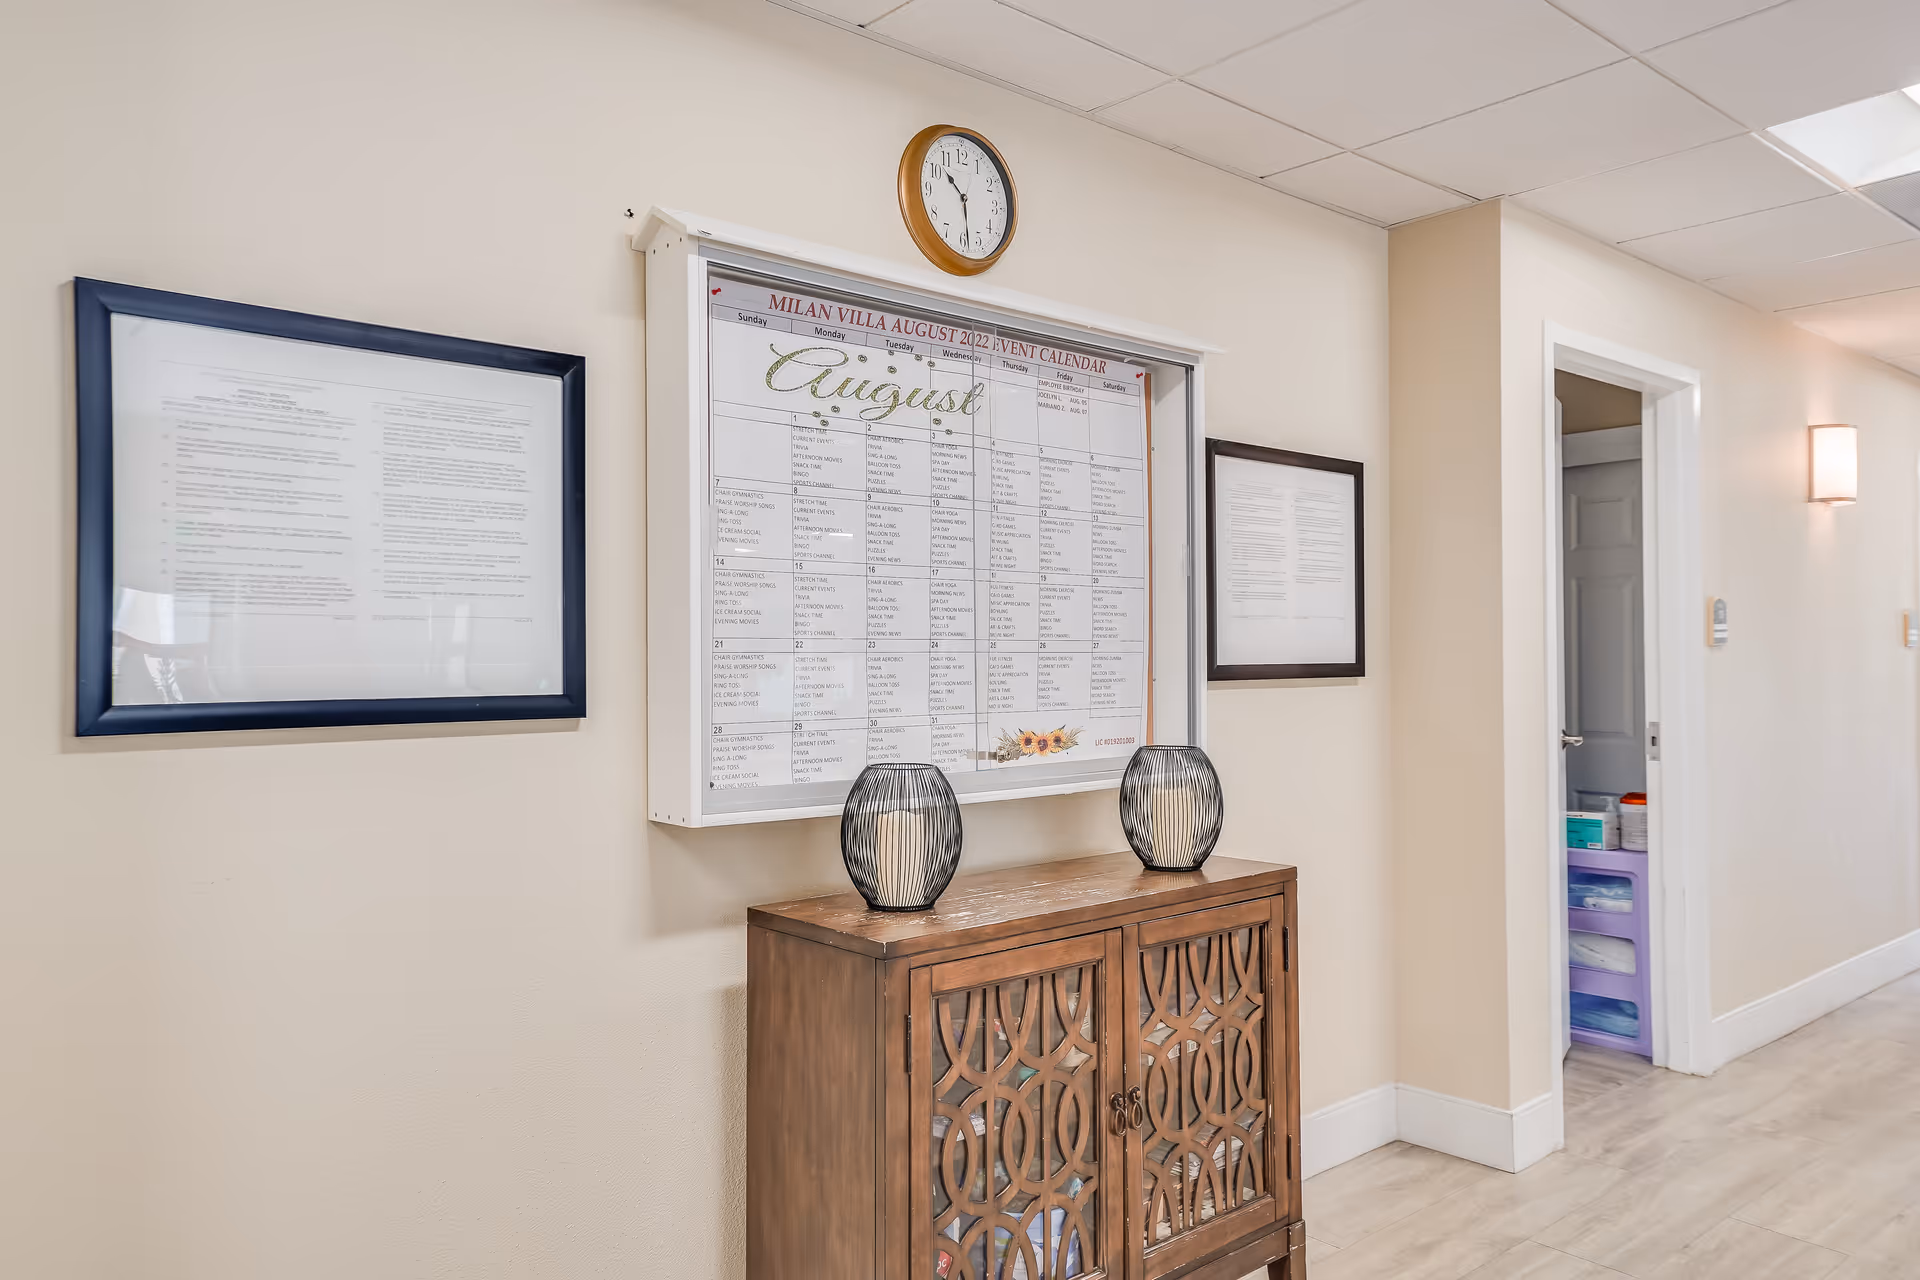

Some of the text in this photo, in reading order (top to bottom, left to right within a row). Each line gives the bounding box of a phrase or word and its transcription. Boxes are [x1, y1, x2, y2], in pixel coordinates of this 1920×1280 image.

[941, 150, 950, 167] 11
[956, 148, 968, 166] 12
[930, 163, 942, 180] 10
[976, 159, 979, 175] 1
[925, 181, 932, 197] 9
[986, 177, 993, 193] 2
[931, 204, 938, 220] 8
[991, 200, 998, 215] 3
[943, 222, 949, 238] 7
[986, 219, 992, 234] 4
[960, 232, 966, 248] 6
[975, 231, 982, 247] 5
[738, 312, 767, 327] Sunday
[768, 294, 1107, 374] MILAN VILLA AUGUST 2022 EVENT CALENDAR
[814, 327, 846, 340] Monday
[885, 340, 914, 352] Tuesday
[1002, 361, 1028, 373] Thursday
[764, 343, 985, 422] August
[1057, 372, 1073, 382] Friday
[1039, 380, 1084, 393] EMPLOYEE BIRTHDAY
[1103, 381, 1126, 392] Saturday
[1038, 392, 1058, 400] JOCELYN
[1038, 402, 1060, 410] MARIANO
[793, 415, 798, 423] 1
[793, 453, 822, 461] AFTERNOON
[715, 479, 720, 488] 7
[732, 491, 764, 499] GYMNASTICS
[794, 487, 798, 495] 8
[715, 558, 725, 566] 14
[795, 562, 803, 570] 15
[868, 566, 875, 574] 16
[715, 640, 723, 648] 21
[869, 719, 878, 727] 30
[931, 716, 938, 724] 31
[713, 726, 723, 734] 28
